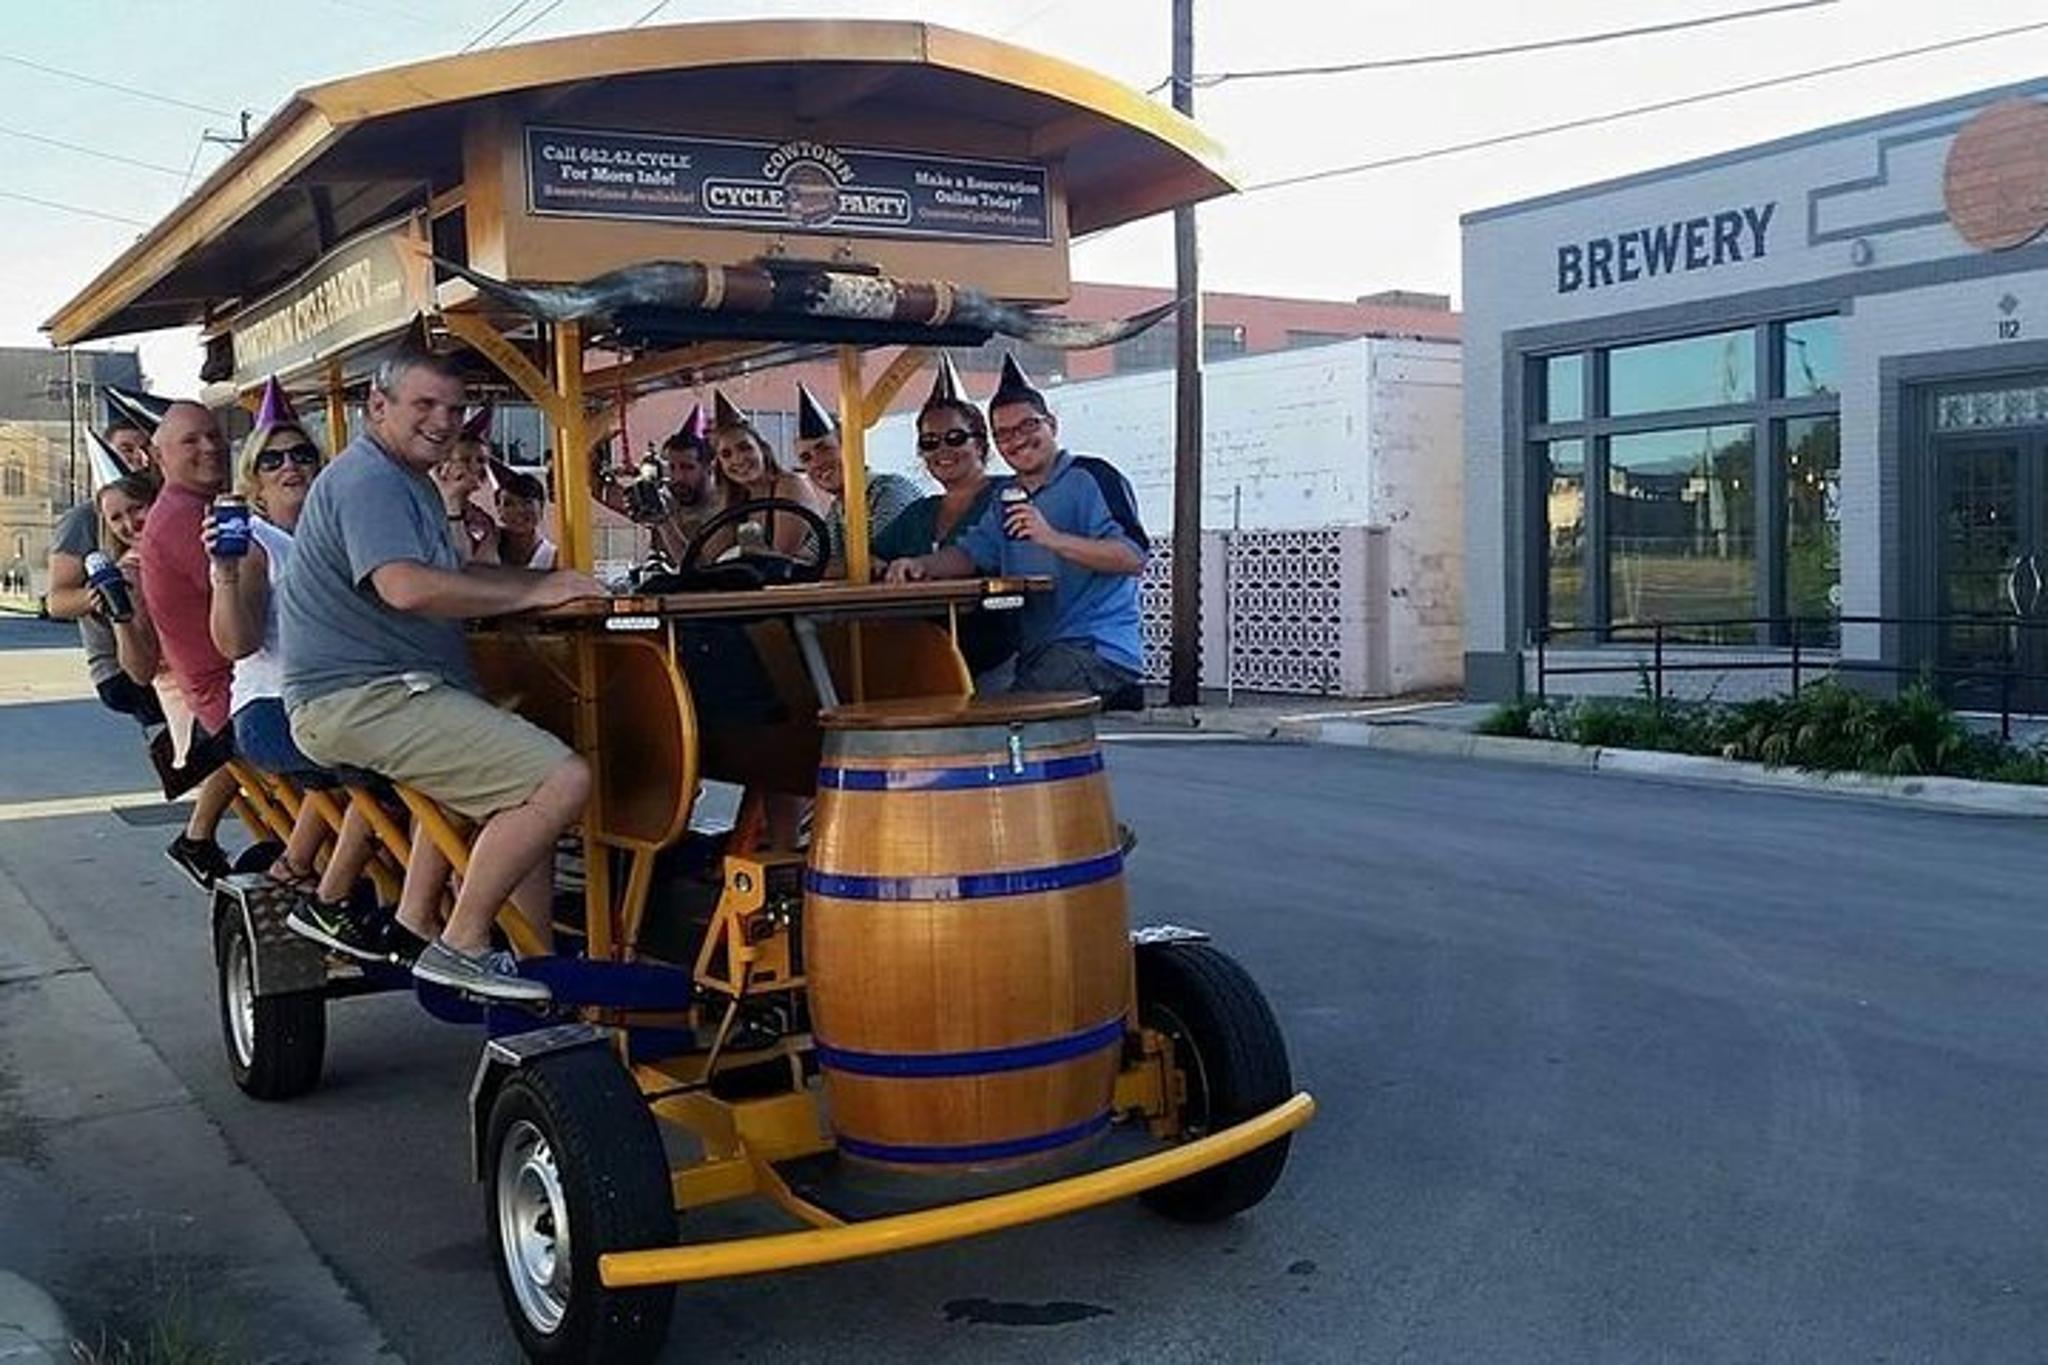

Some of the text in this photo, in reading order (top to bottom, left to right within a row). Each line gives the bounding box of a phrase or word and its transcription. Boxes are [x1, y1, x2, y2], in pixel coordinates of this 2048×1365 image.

[542, 144, 577, 161] Call
[762, 141, 856, 183] COWTOWN
[560, 164, 676, 186] For More Info!
[915, 171, 953, 187] Make
[709, 186, 907, 216] CYCLE PARTY
[935, 189, 978, 206] Online
[1557, 201, 1777, 294] BREWERY
[1999, 319, 2020, 339] 112
